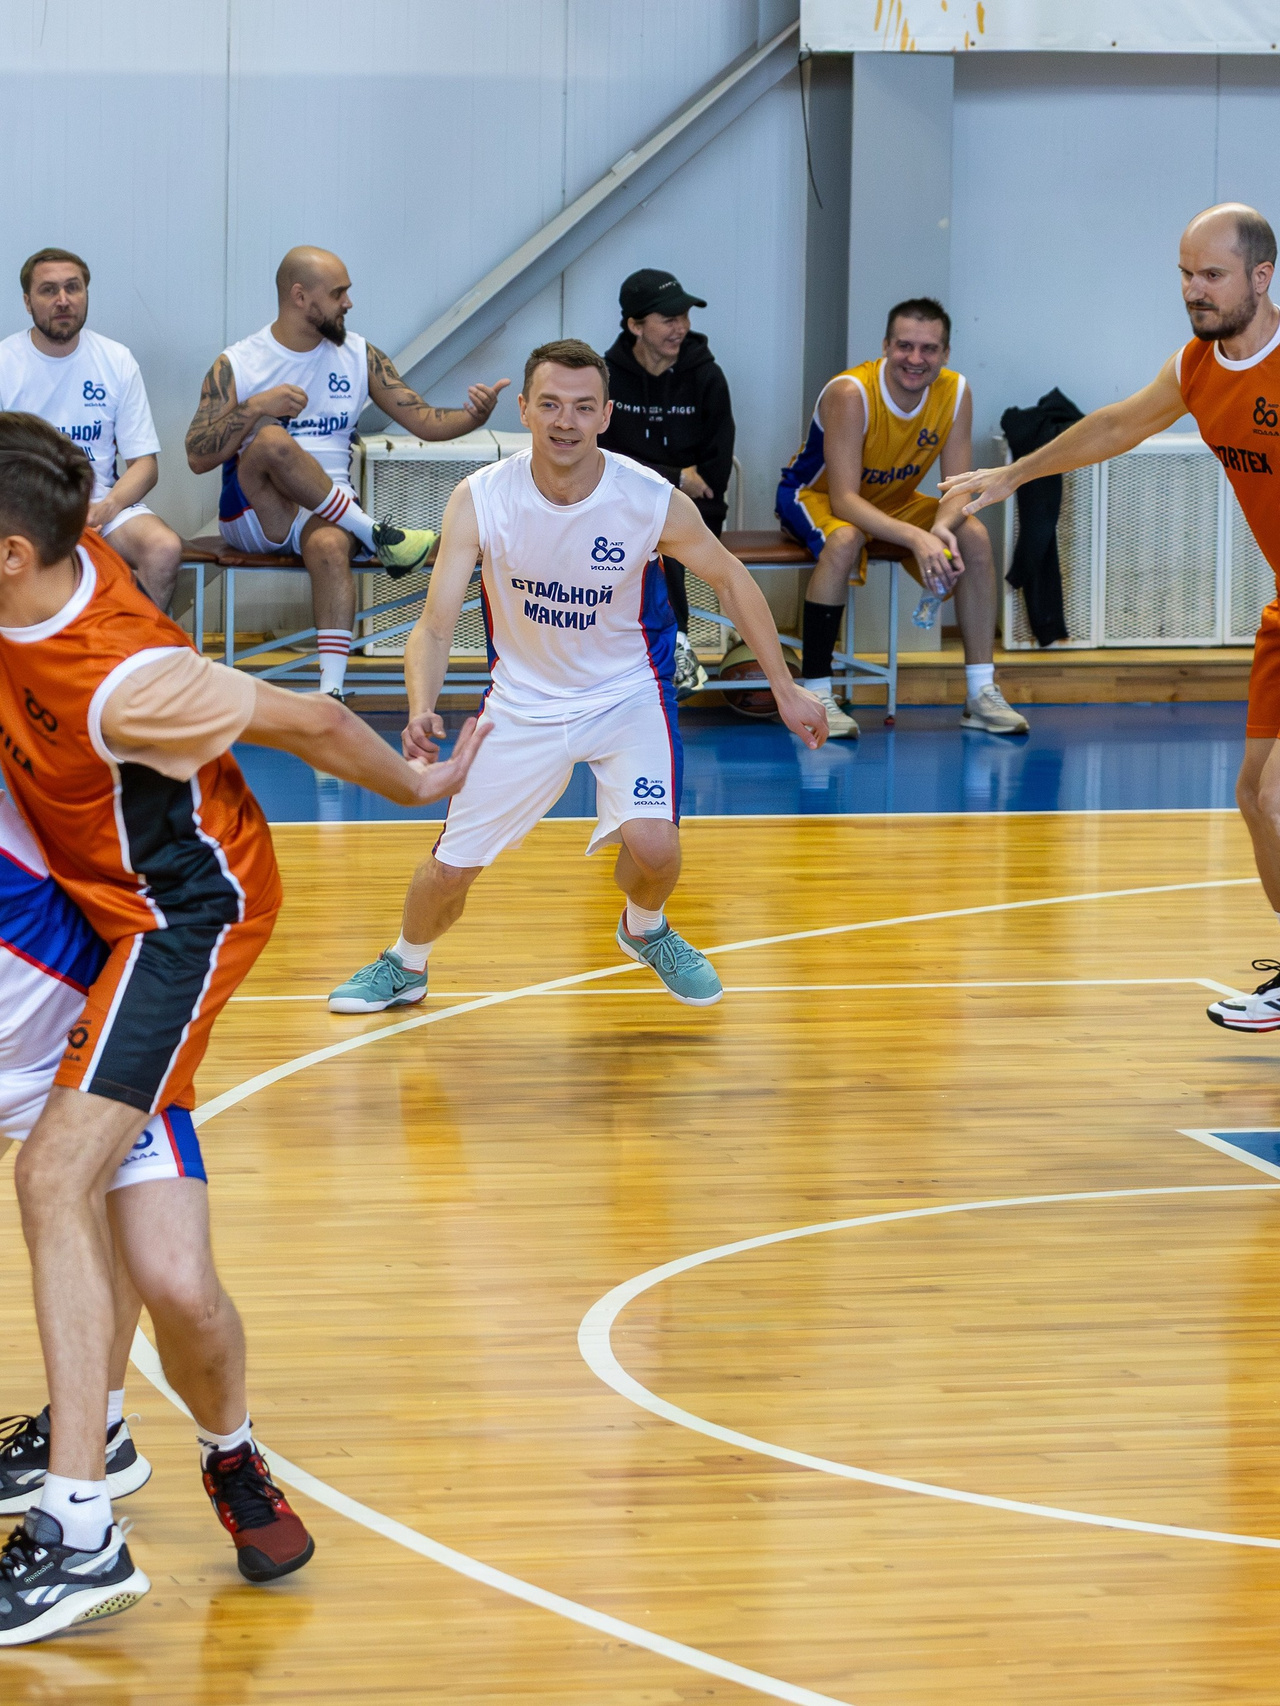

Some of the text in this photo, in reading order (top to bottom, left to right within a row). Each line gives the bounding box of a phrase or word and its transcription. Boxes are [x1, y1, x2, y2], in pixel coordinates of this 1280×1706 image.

[1253, 396, 1278, 428] 80
[591, 536, 625, 563] 80
[511, 578, 613, 607] СТАЛЬНОЙ
[524, 599, 597, 630] МЯКИШ
[633, 777, 666, 798] 80
